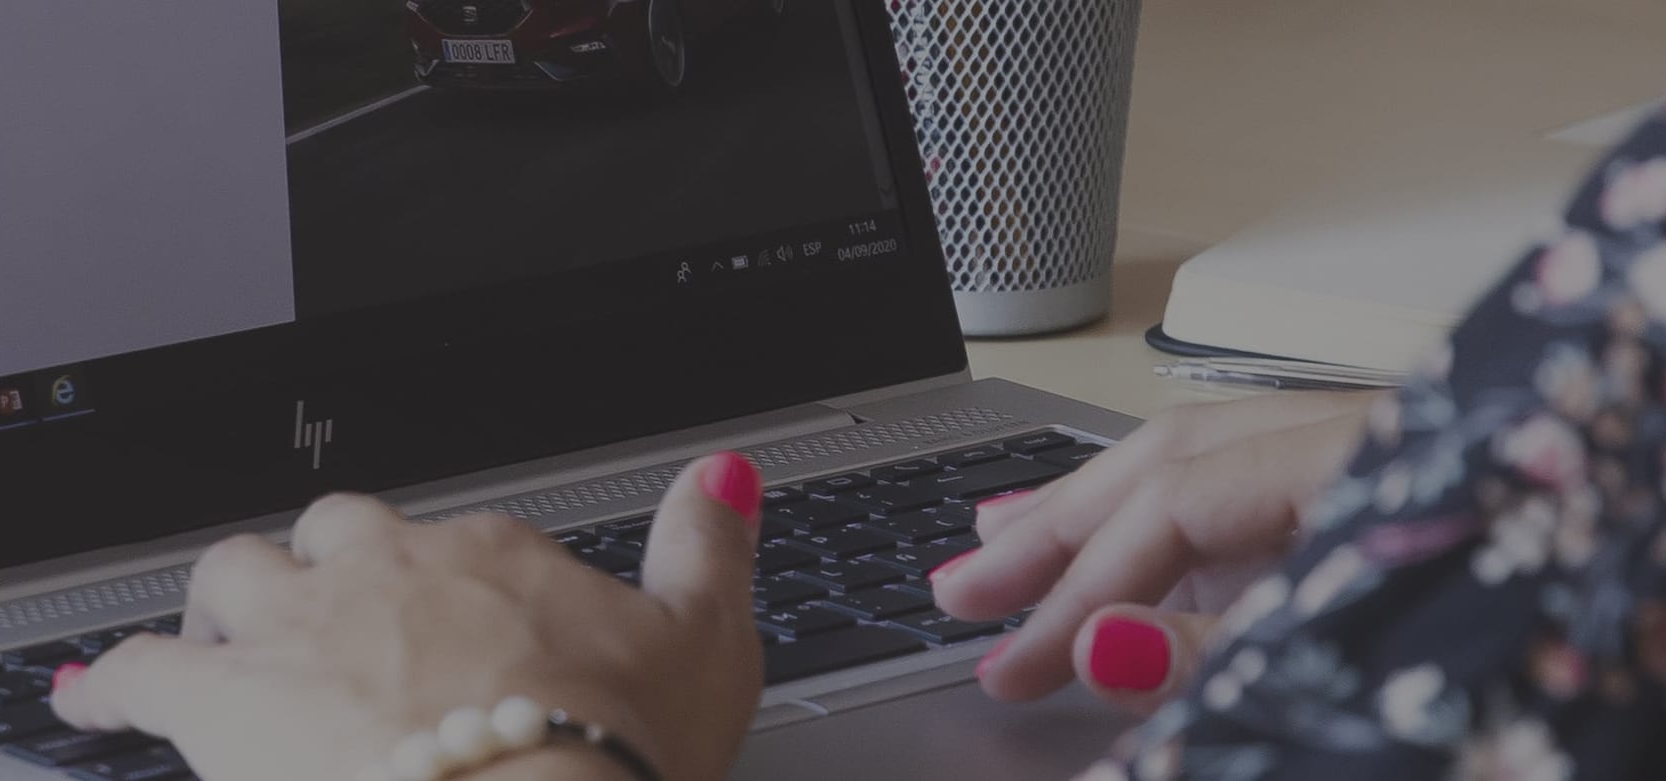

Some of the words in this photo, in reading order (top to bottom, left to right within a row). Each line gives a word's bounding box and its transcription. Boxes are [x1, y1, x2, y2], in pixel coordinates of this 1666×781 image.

[451, 44, 482, 60] 0008
[848, 220, 876, 235] 11:14
[803, 241, 821, 256] ESP
[837, 238, 897, 261] 04/09/2020
[294, 400, 333, 470] hp
